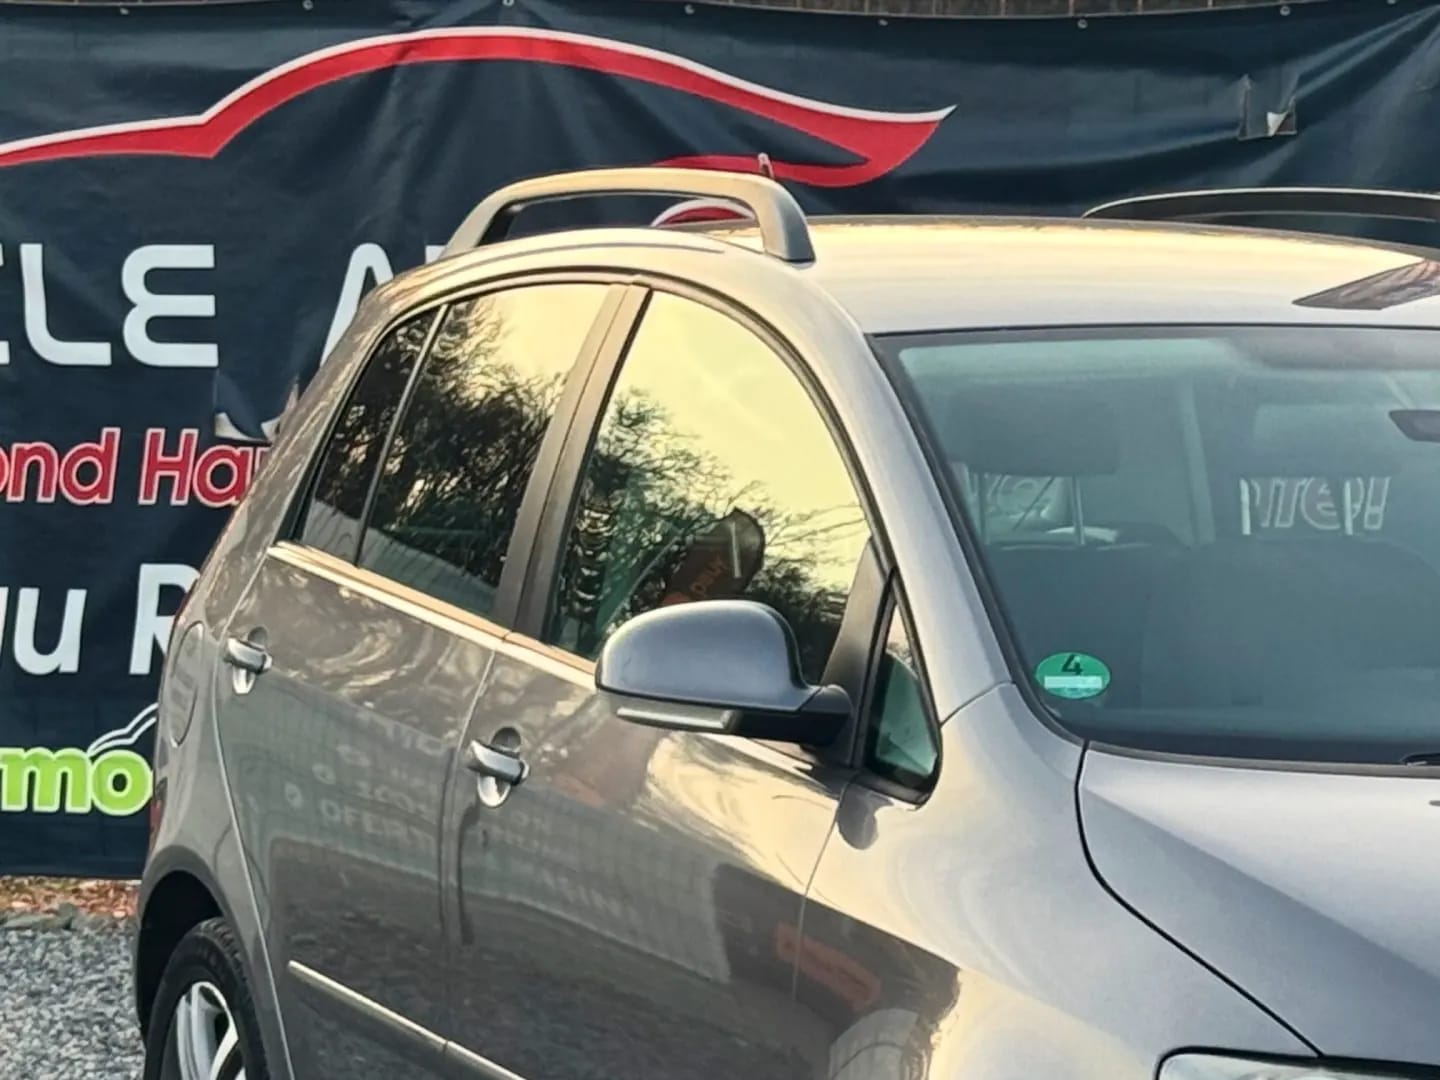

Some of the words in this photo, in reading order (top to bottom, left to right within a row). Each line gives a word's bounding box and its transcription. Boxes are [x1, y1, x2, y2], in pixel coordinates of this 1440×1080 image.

[0, 243, 219, 367] LE
[0, 427, 121, 504] nd
[138, 428, 276, 508] Ha
[1061, 653, 1083, 675] 4
